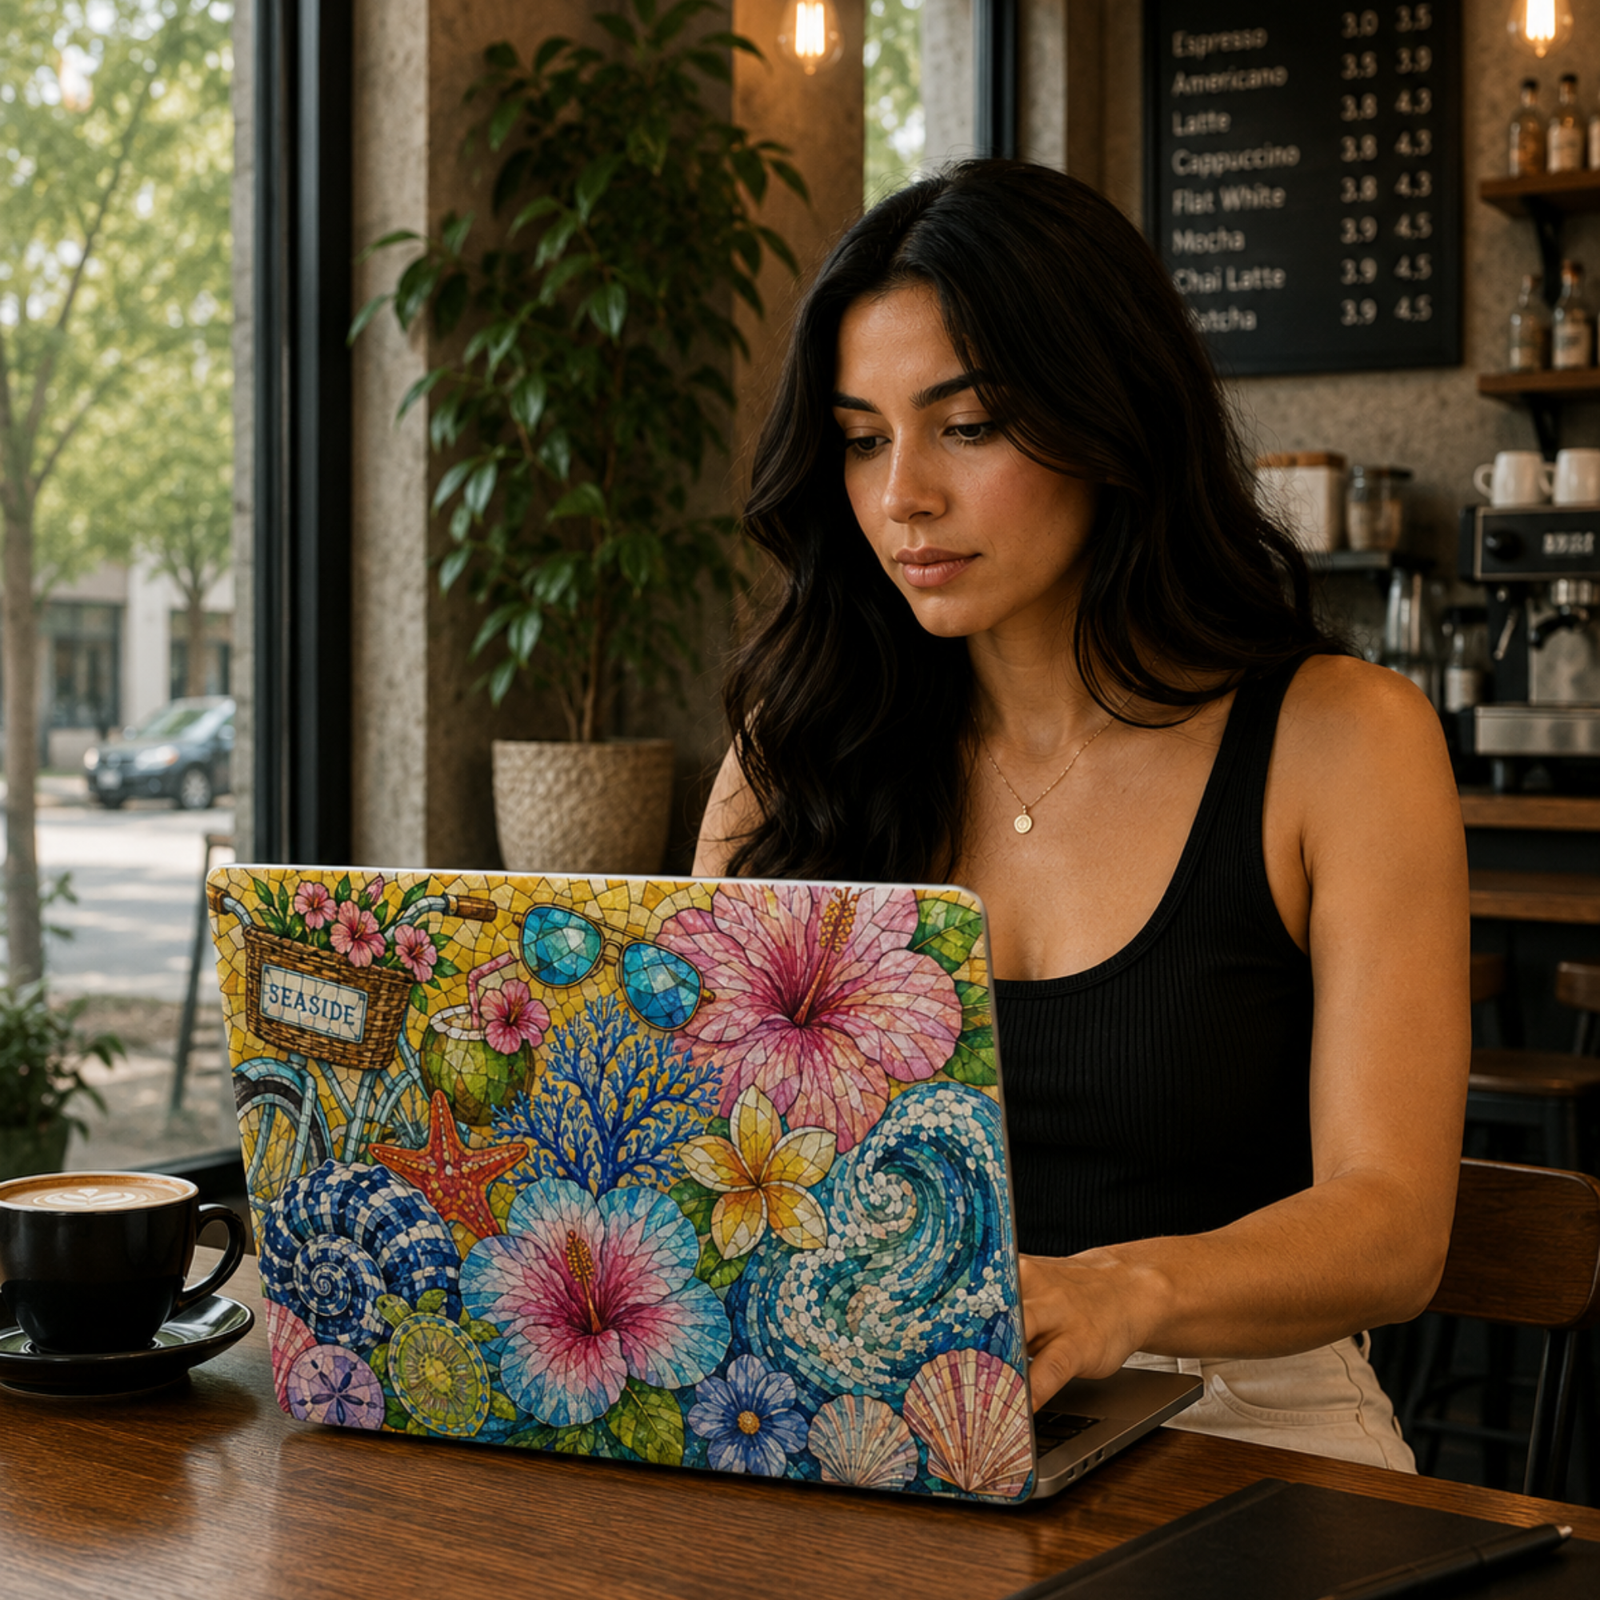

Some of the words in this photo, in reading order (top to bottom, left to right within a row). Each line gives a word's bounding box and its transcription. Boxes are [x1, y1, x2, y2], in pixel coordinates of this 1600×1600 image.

[1173, 28, 1267, 58] Espresso
[1343, 9, 1379, 39] 3.0
[1396, 3, 1432, 33] 3.5
[1172, 66, 1287, 96] Americano
[1342, 51, 1378, 80] 3.5
[1397, 45, 1432, 74] 3.9
[1173, 111, 1230, 136] Latte
[1341, 93, 1378, 122] 3.8
[1394, 88, 1432, 115] 4.3
[1172, 143, 1300, 176] Cappuccino
[1341, 134, 1378, 163] 3.8
[1394, 128, 1432, 157] 4.3
[1173, 188, 1215, 215] Flat
[1220, 184, 1286, 211] White
[1341, 175, 1378, 203] 3.8
[1394, 170, 1432, 198] 4.3
[1173, 227, 1245, 254] Mocha
[1340, 216, 1378, 245] 3.9
[1394, 211, 1432, 239] 4.5
[1173, 267, 1222, 294] Chai
[1226, 267, 1285, 291] Latte
[1342, 257, 1378, 285] 3.9
[1394, 253, 1432, 280] 4.5
[1186, 306, 1256, 332] atcha
[1341, 298, 1377, 326] 3.9
[1394, 294, 1432, 321] 4.5
[268, 983, 356, 1026] SEASIDE
